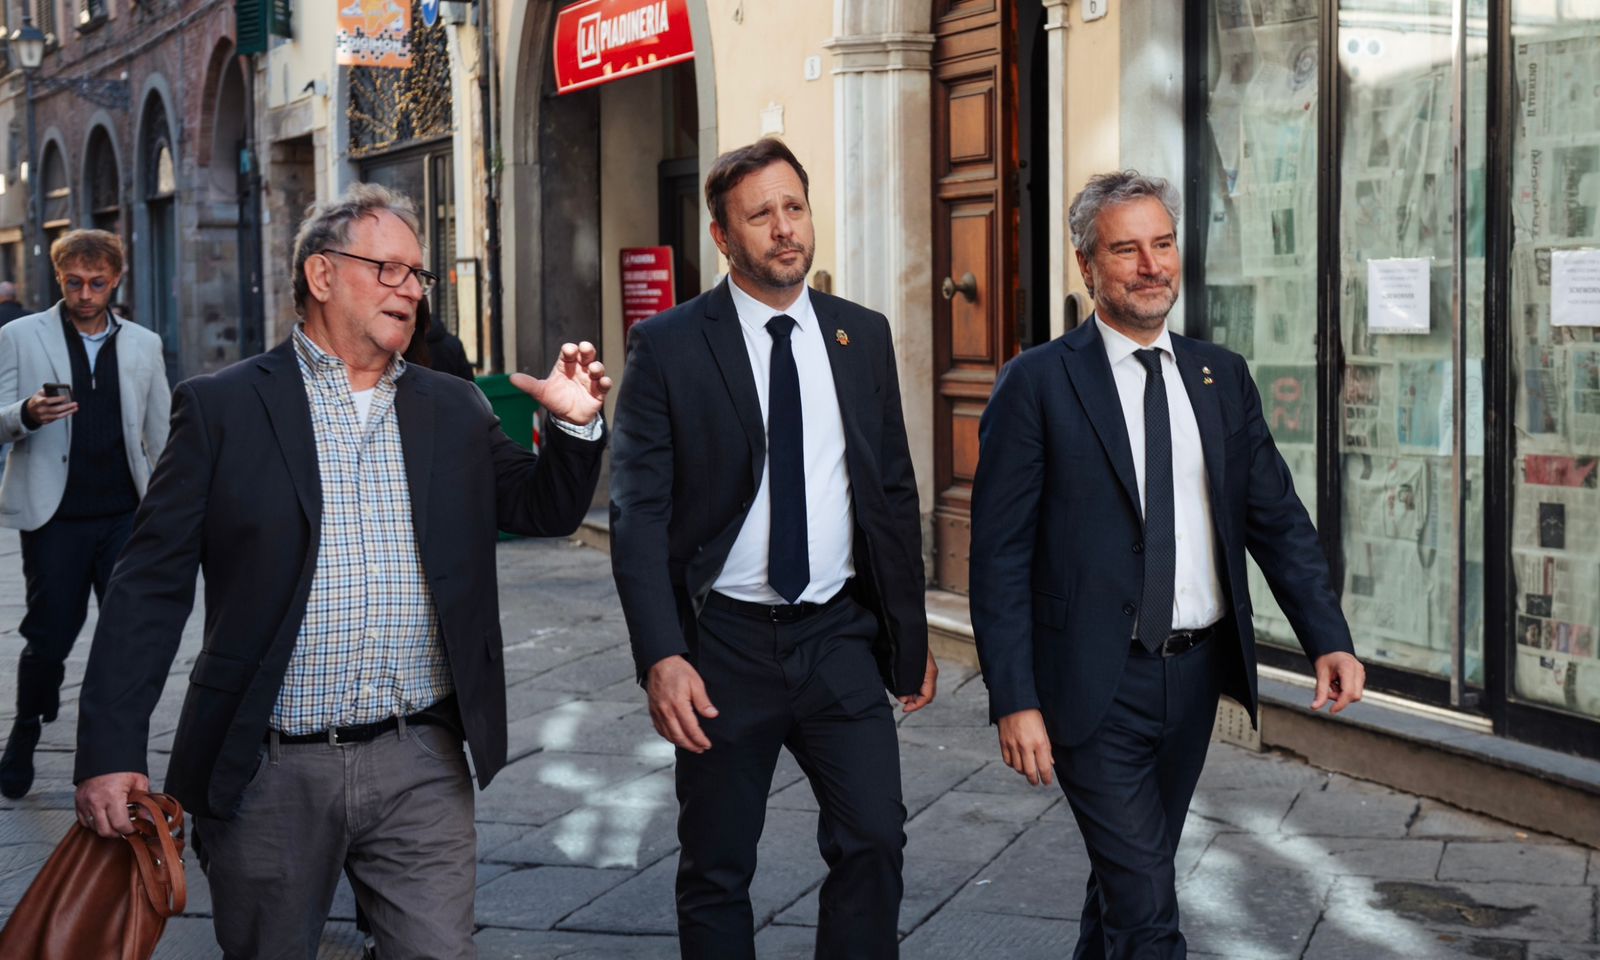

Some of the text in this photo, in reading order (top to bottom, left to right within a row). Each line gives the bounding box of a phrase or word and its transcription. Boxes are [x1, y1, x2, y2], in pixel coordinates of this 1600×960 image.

[580, 0, 670, 58] LA PIADINERIA
[1527, 62, 1538, 107] TIRRENO
